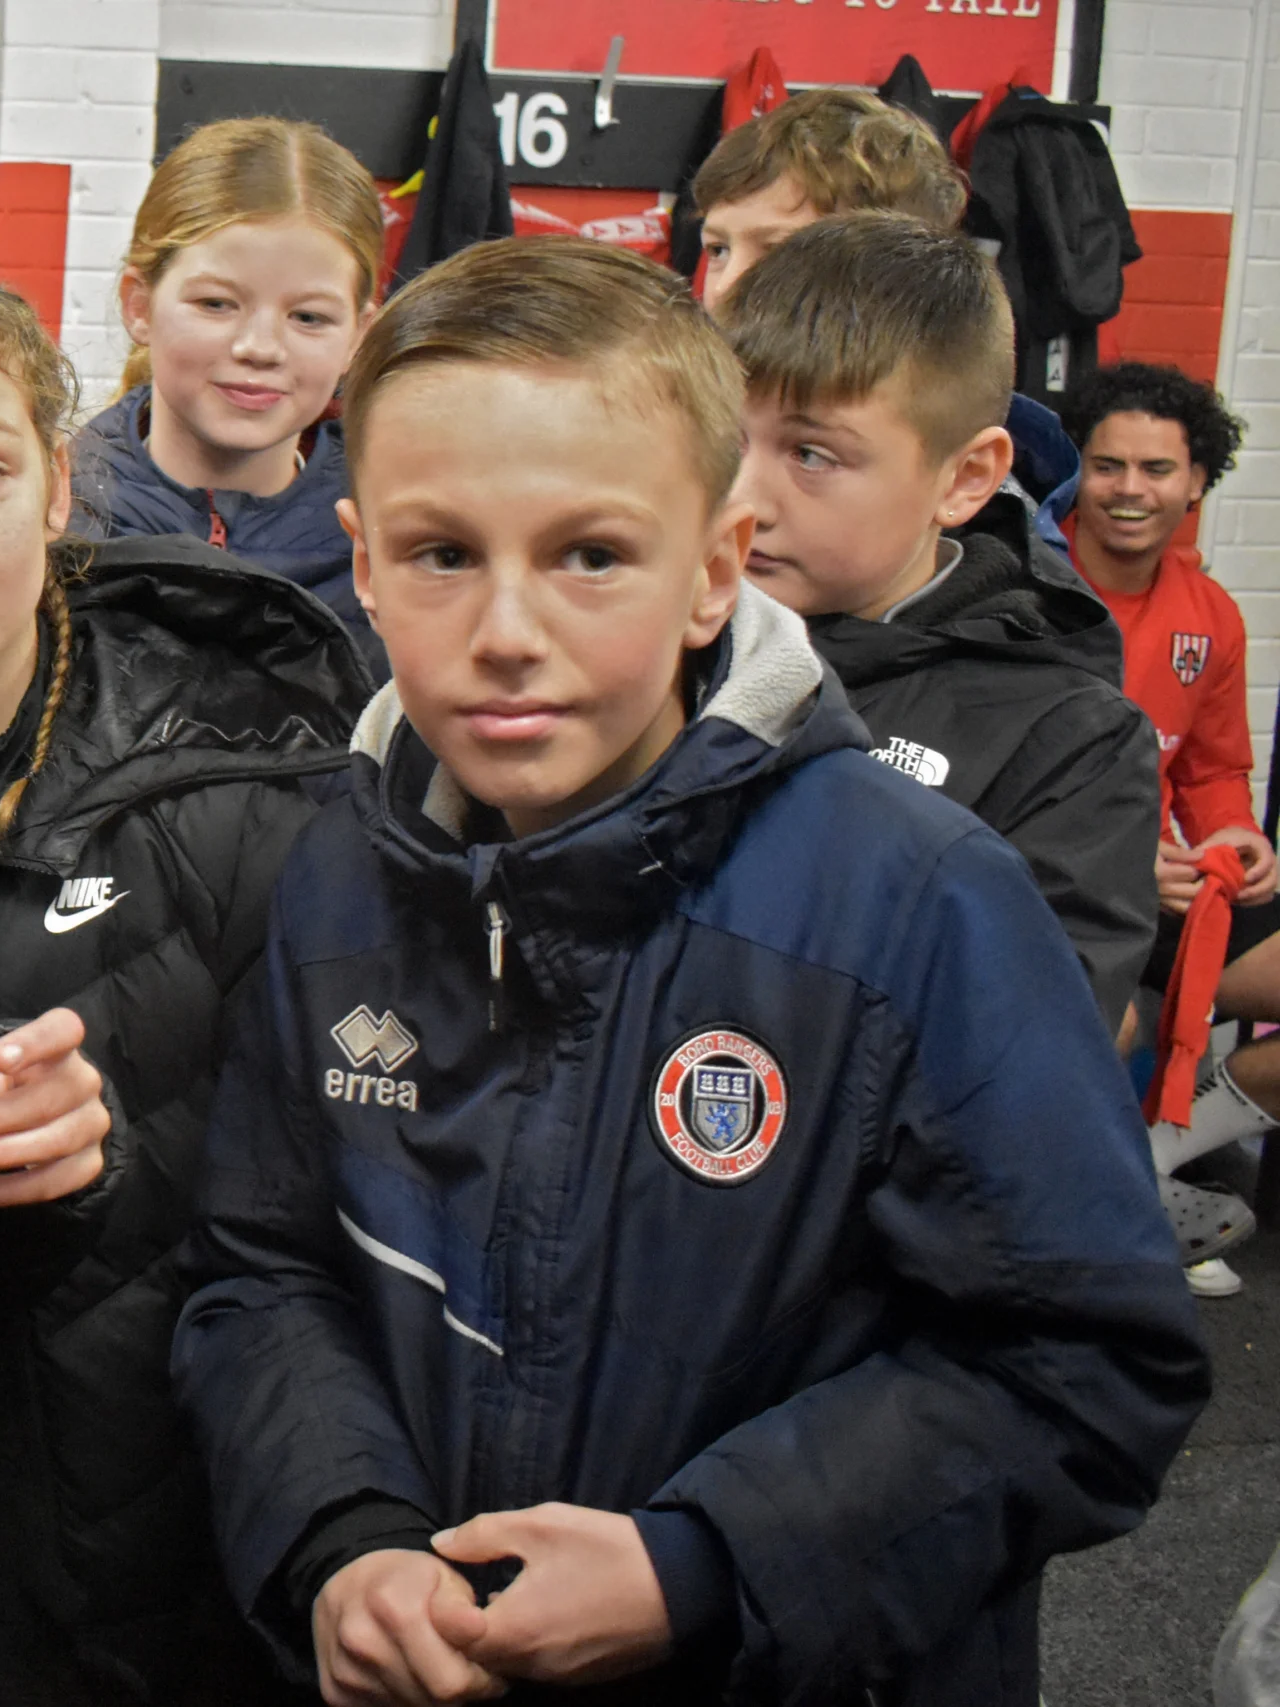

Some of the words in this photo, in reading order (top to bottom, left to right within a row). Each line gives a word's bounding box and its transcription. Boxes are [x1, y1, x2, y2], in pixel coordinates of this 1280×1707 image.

[493, 92, 569, 169] 16
[867, 748, 921, 774] ORTH
[888, 736, 925, 760] THE
[56, 876, 114, 909] NIKE
[676, 1037, 715, 1068] BORO
[717, 1035, 773, 1076] RANGERS
[324, 1068, 419, 1112] errea
[670, 1131, 734, 1174] FOOTBALL
[735, 1140, 767, 1170] CLUB
